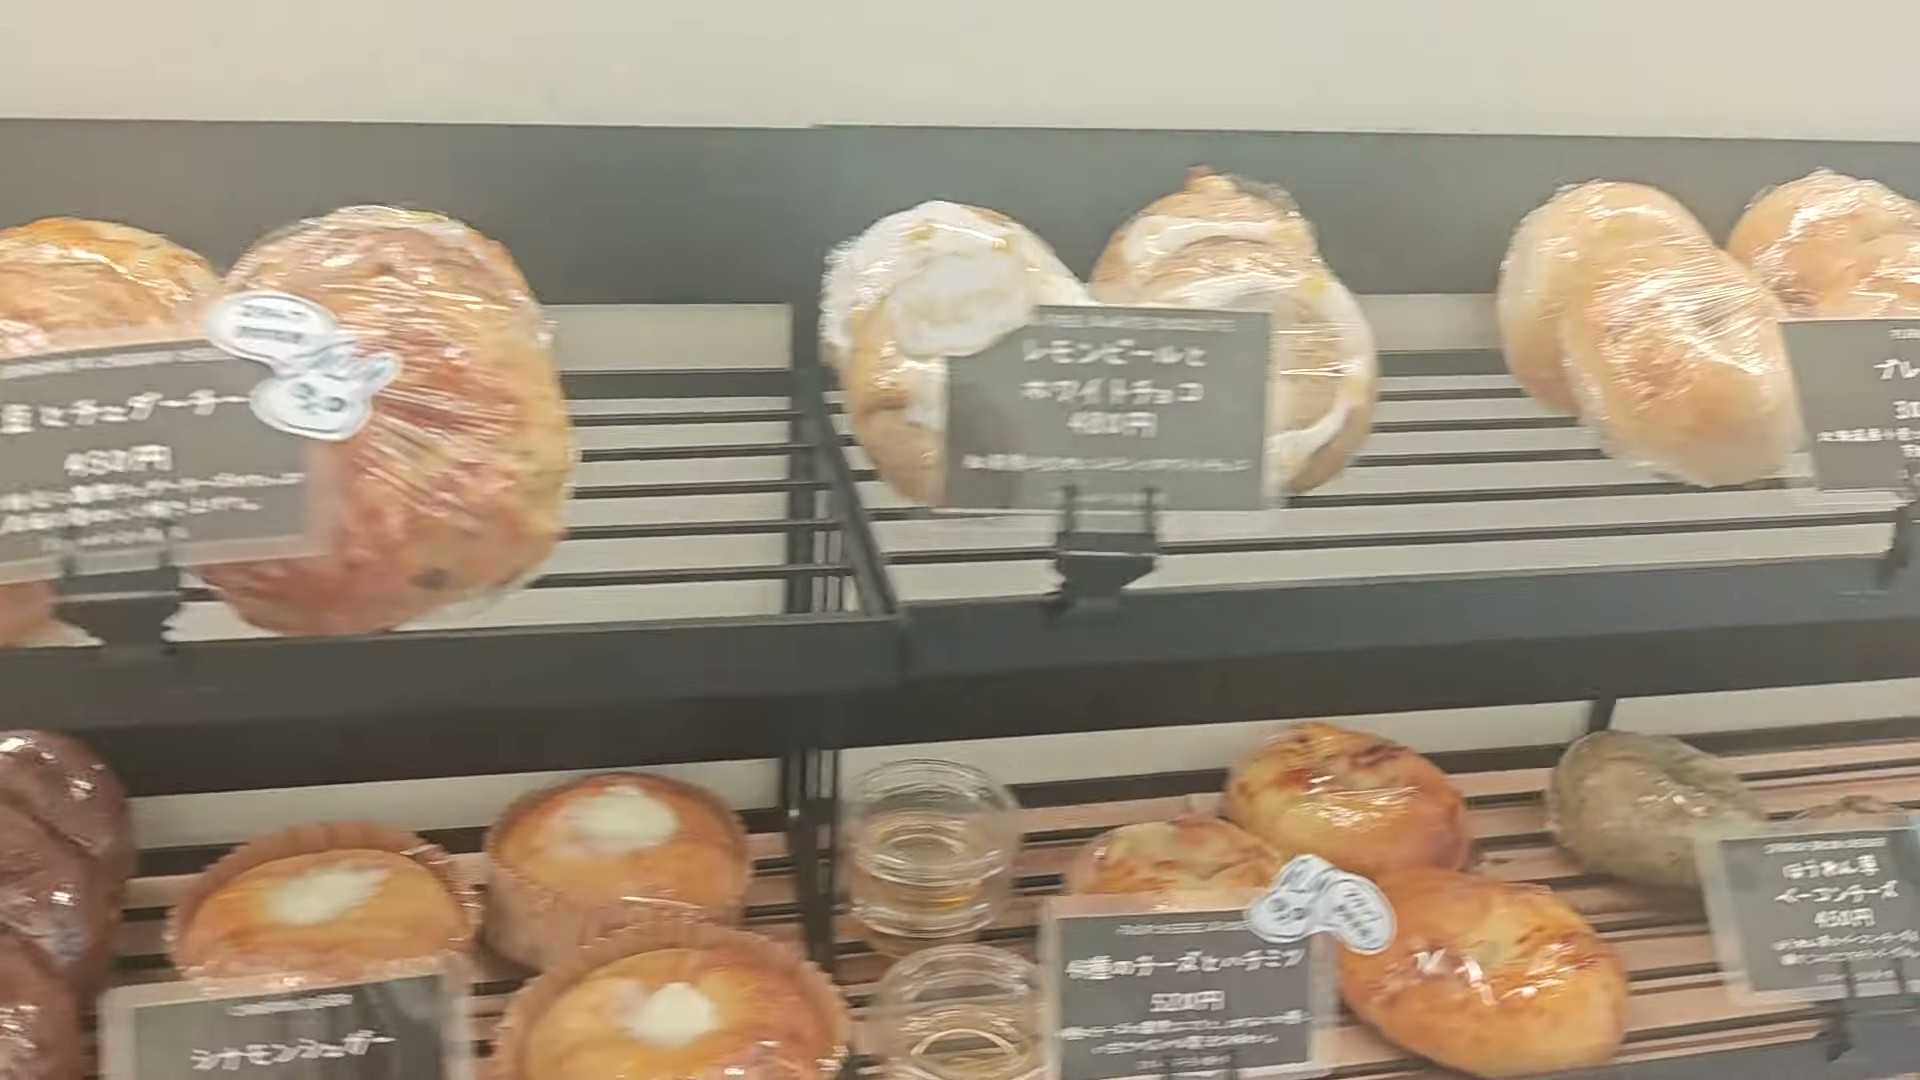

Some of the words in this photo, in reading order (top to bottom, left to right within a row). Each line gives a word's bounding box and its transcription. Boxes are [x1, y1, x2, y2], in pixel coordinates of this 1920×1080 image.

[1020, 379, 1204, 405] ホワイトチョコ
[191, 1030, 396, 1071] シナモンシュガー
